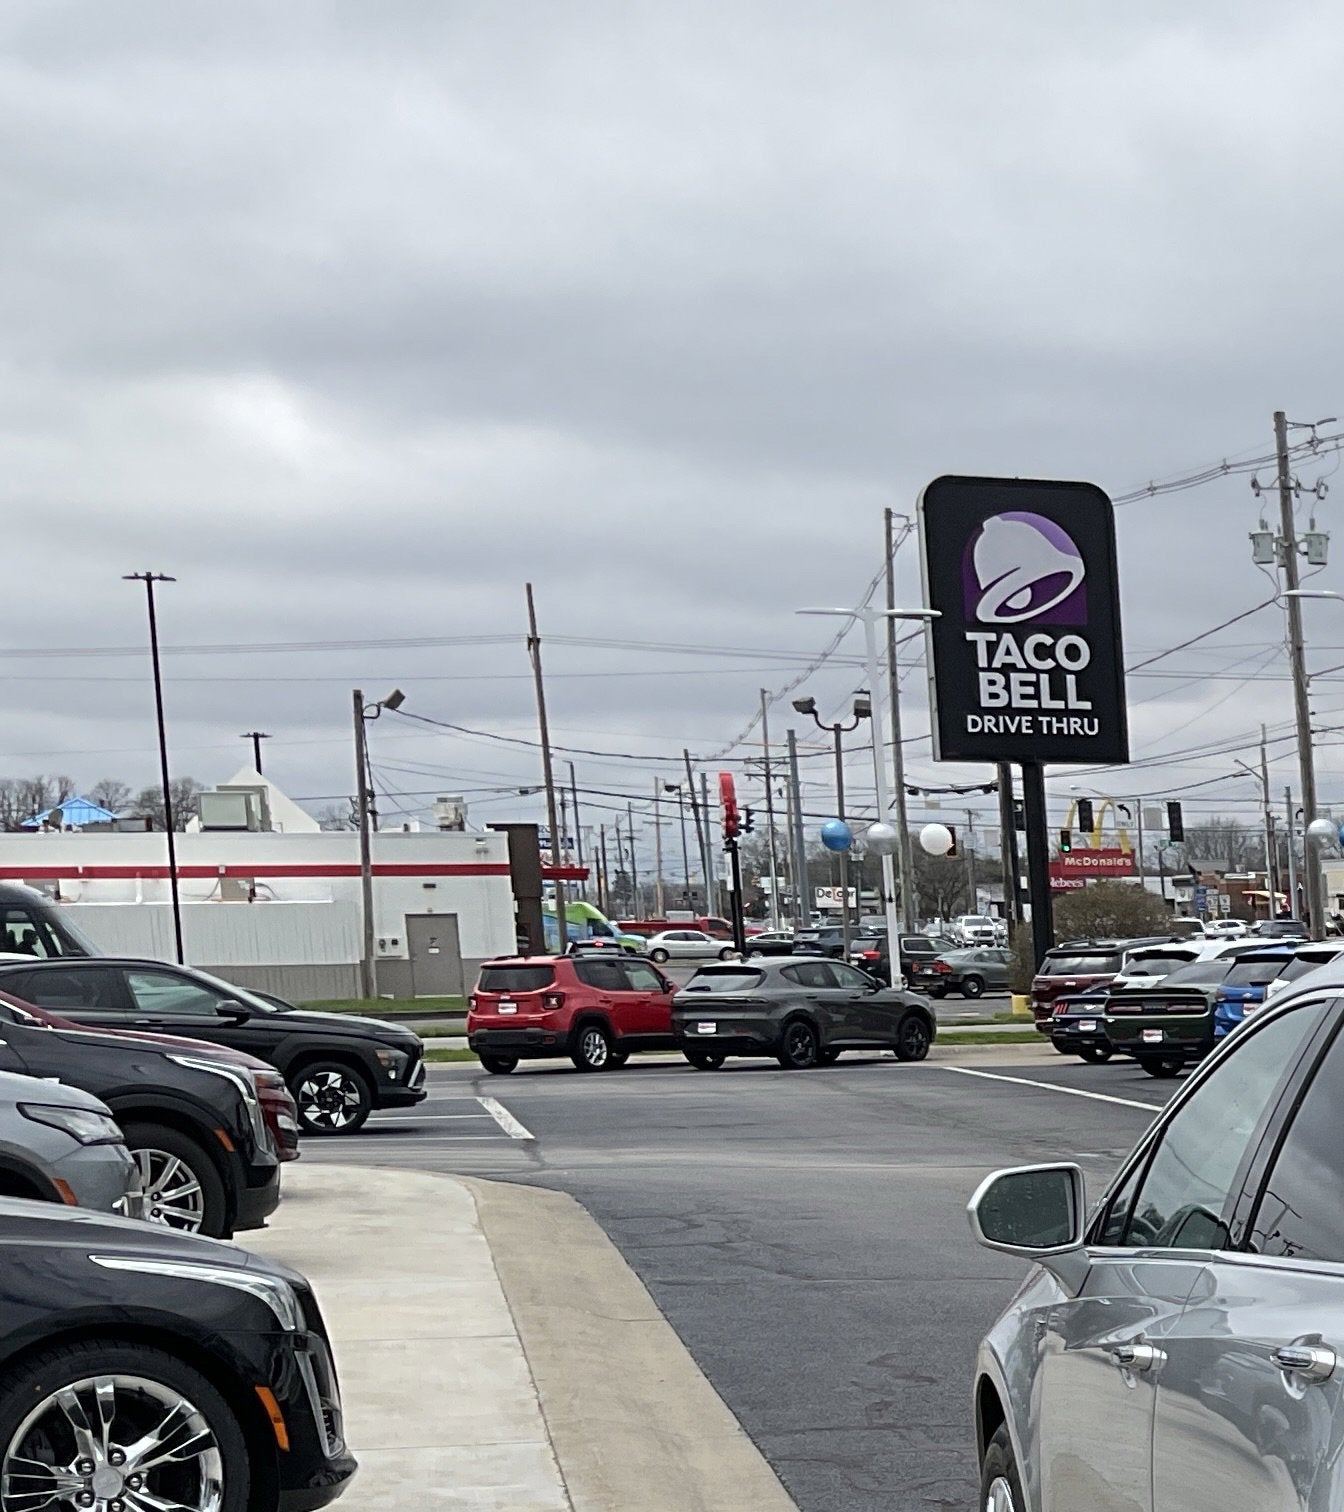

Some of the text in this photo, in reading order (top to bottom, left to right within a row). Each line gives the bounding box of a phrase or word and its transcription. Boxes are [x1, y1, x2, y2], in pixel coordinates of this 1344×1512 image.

[965, 631, 1091, 672] TACO
[978, 671, 1093, 710] BELL
[966, 714, 1100, 736] DRIVE THRU
[1064, 856, 1132, 867] McDonald's
